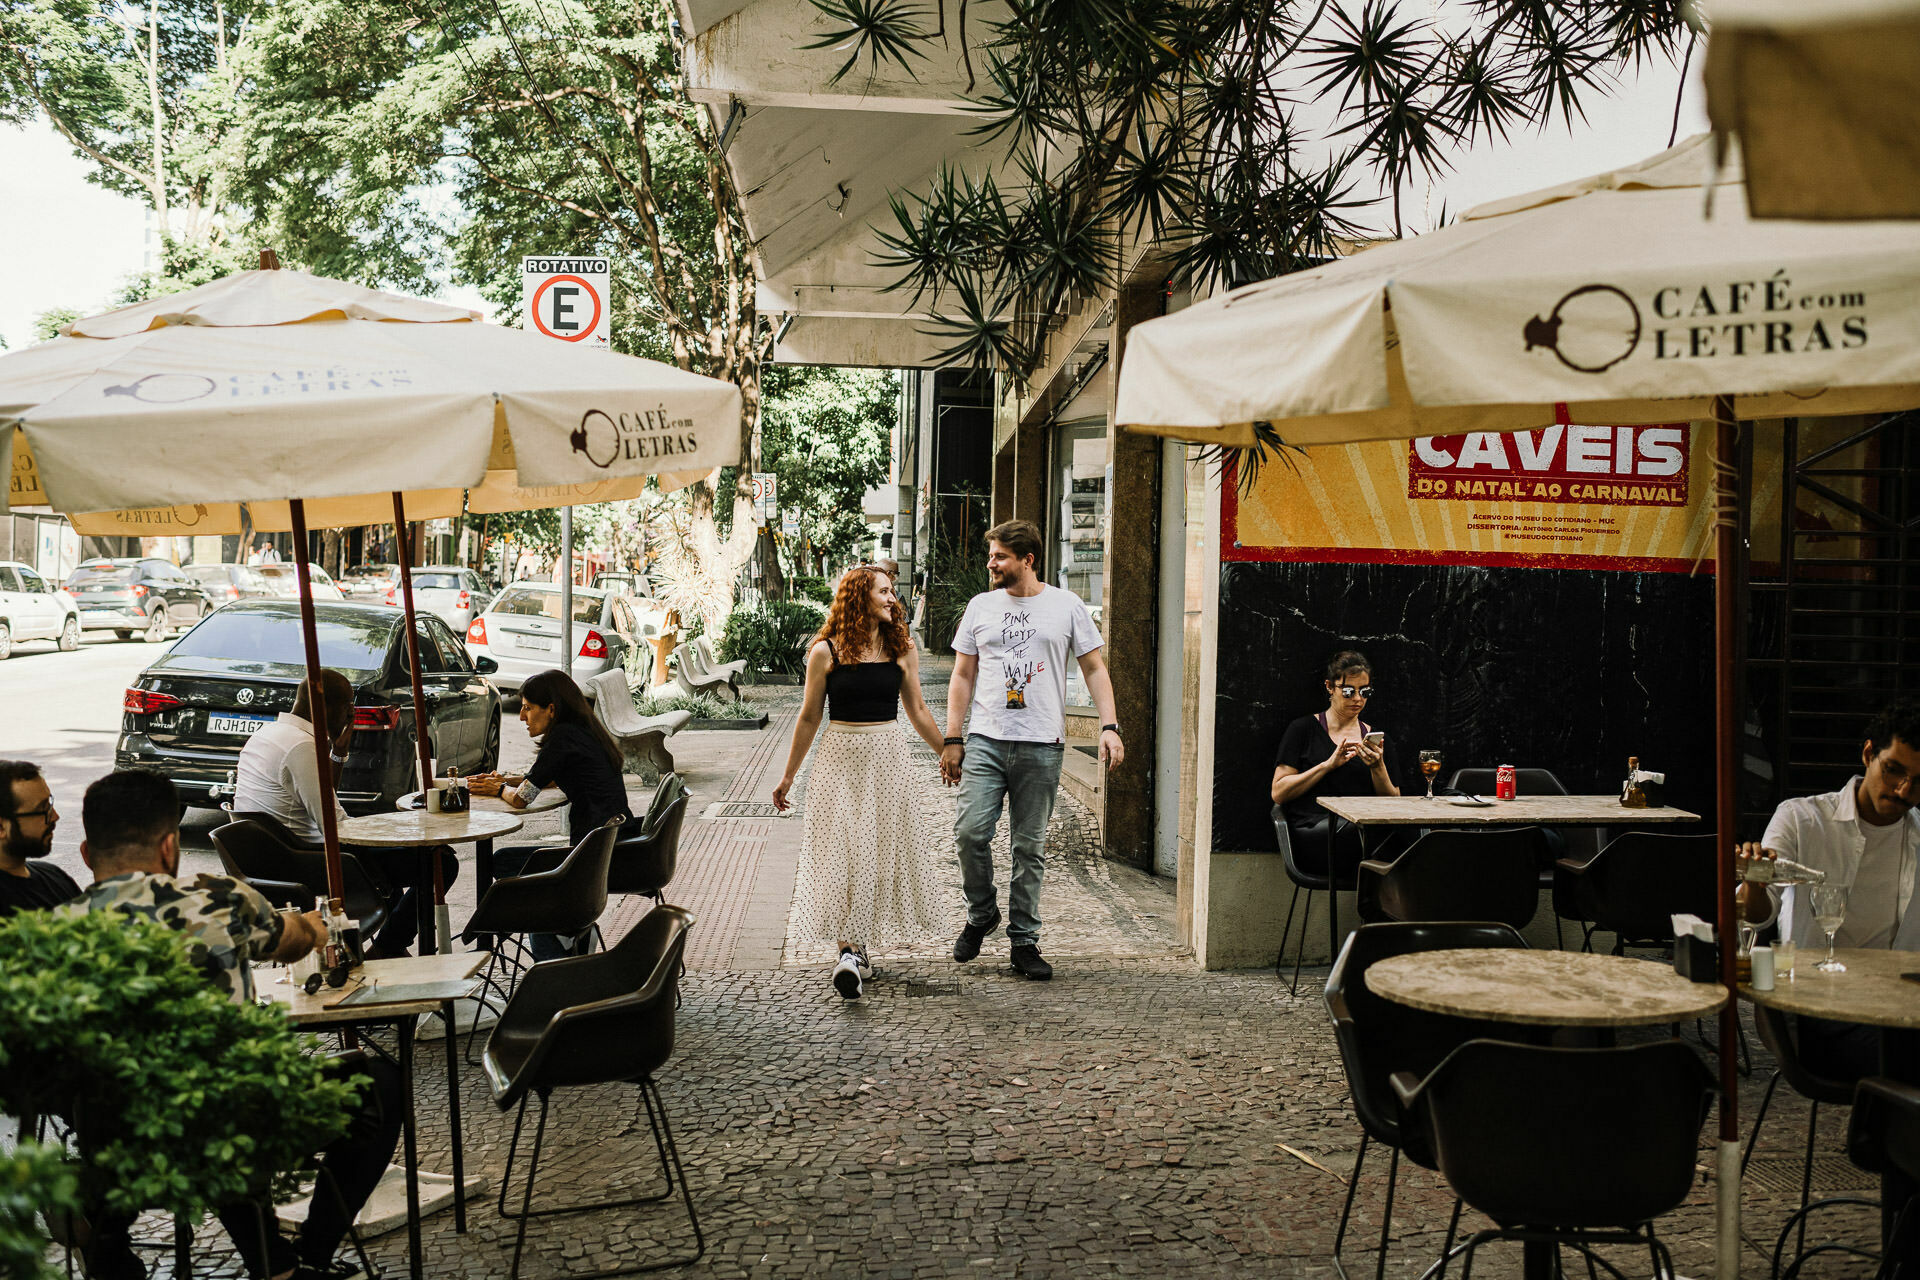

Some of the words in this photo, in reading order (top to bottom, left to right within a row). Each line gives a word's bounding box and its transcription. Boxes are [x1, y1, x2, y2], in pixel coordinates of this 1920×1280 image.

[527, 260, 606, 272] ROTATIVO
[1652, 268, 1792, 319] CAFÉ
[1799, 291, 1865, 310] com
[553, 287, 579, 330] E
[1654, 316, 1868, 360] LETRAS
[619, 402, 671, 433] CAFÉ
[671, 418, 693, 428] com
[624, 432, 697, 460] LETRAS
[1417, 479, 1448, 493] DO
[1455, 480, 1526, 496] NATAL
[1532, 483, 1562, 498] AO
[1569, 484, 1683, 502] CARNAVAL
[1001, 610, 1031, 627] PINK
[1001, 624, 1037, 645] FLOYD
[1004, 641, 1030, 660] THE
[214, 718, 264, 733] RJH1G7
